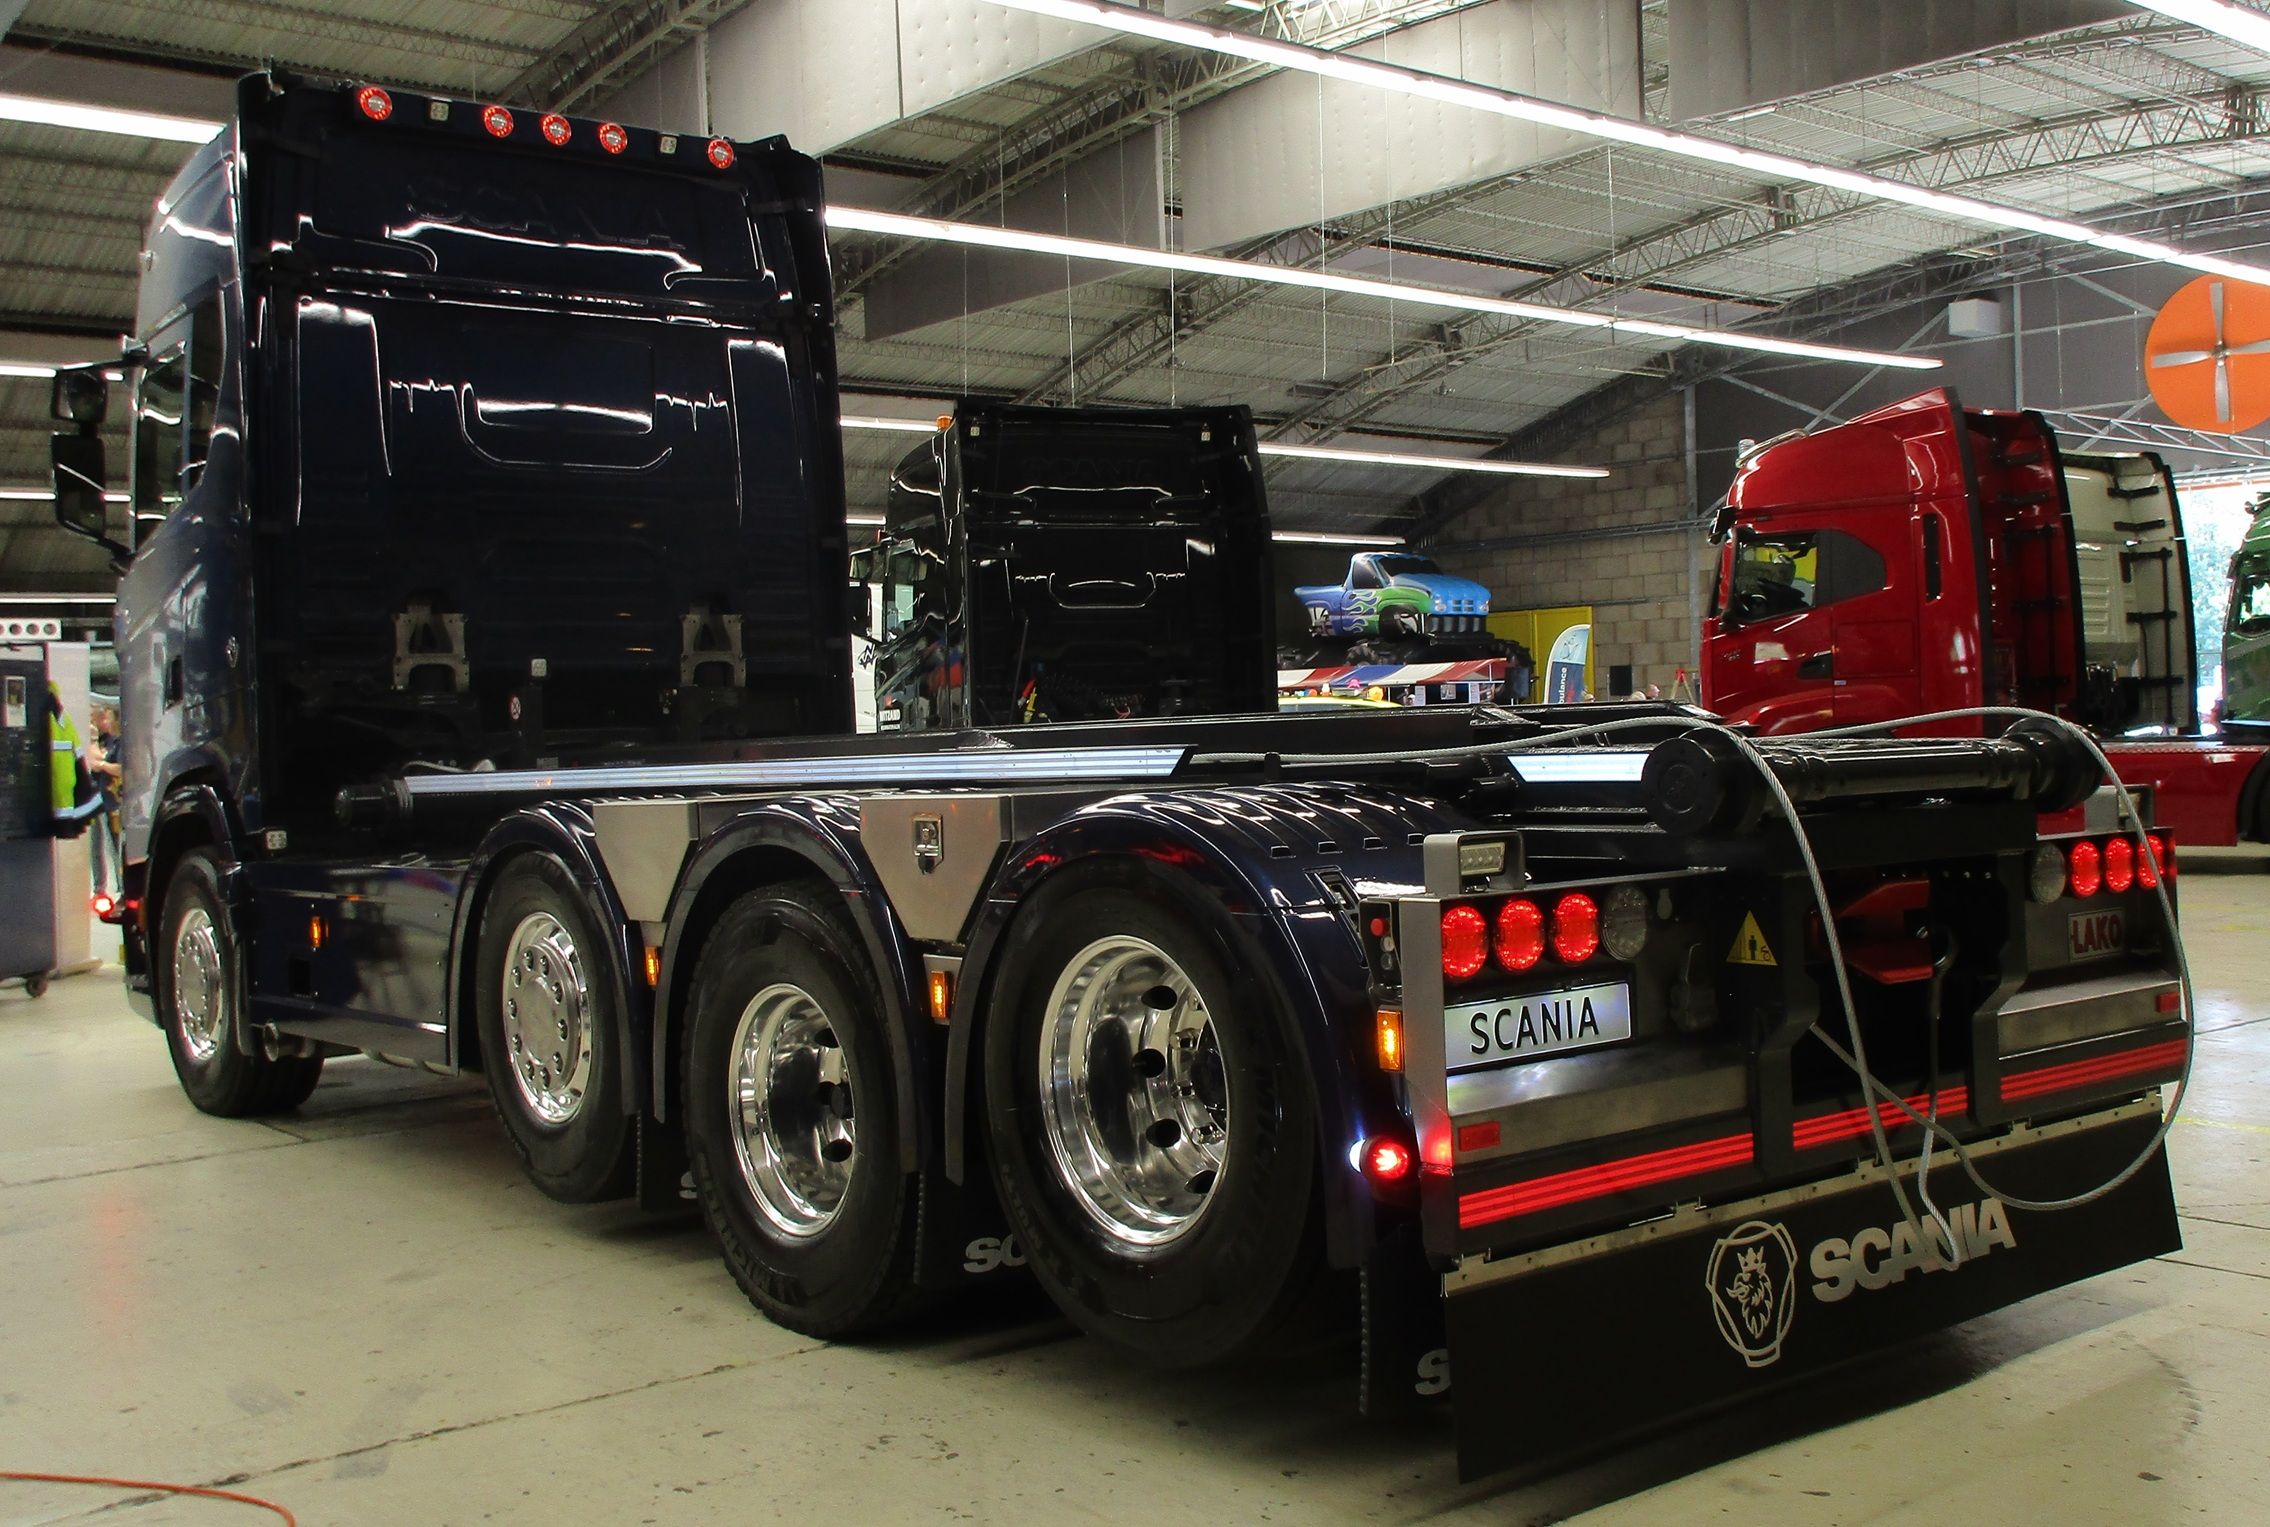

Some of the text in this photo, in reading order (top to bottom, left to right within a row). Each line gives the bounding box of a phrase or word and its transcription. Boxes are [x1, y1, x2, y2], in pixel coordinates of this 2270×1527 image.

[2072, 914, 2121, 954] LAKO
[1470, 996, 1599, 1054] SCANIA
[1810, 1197, 2017, 1302] SCANIA
